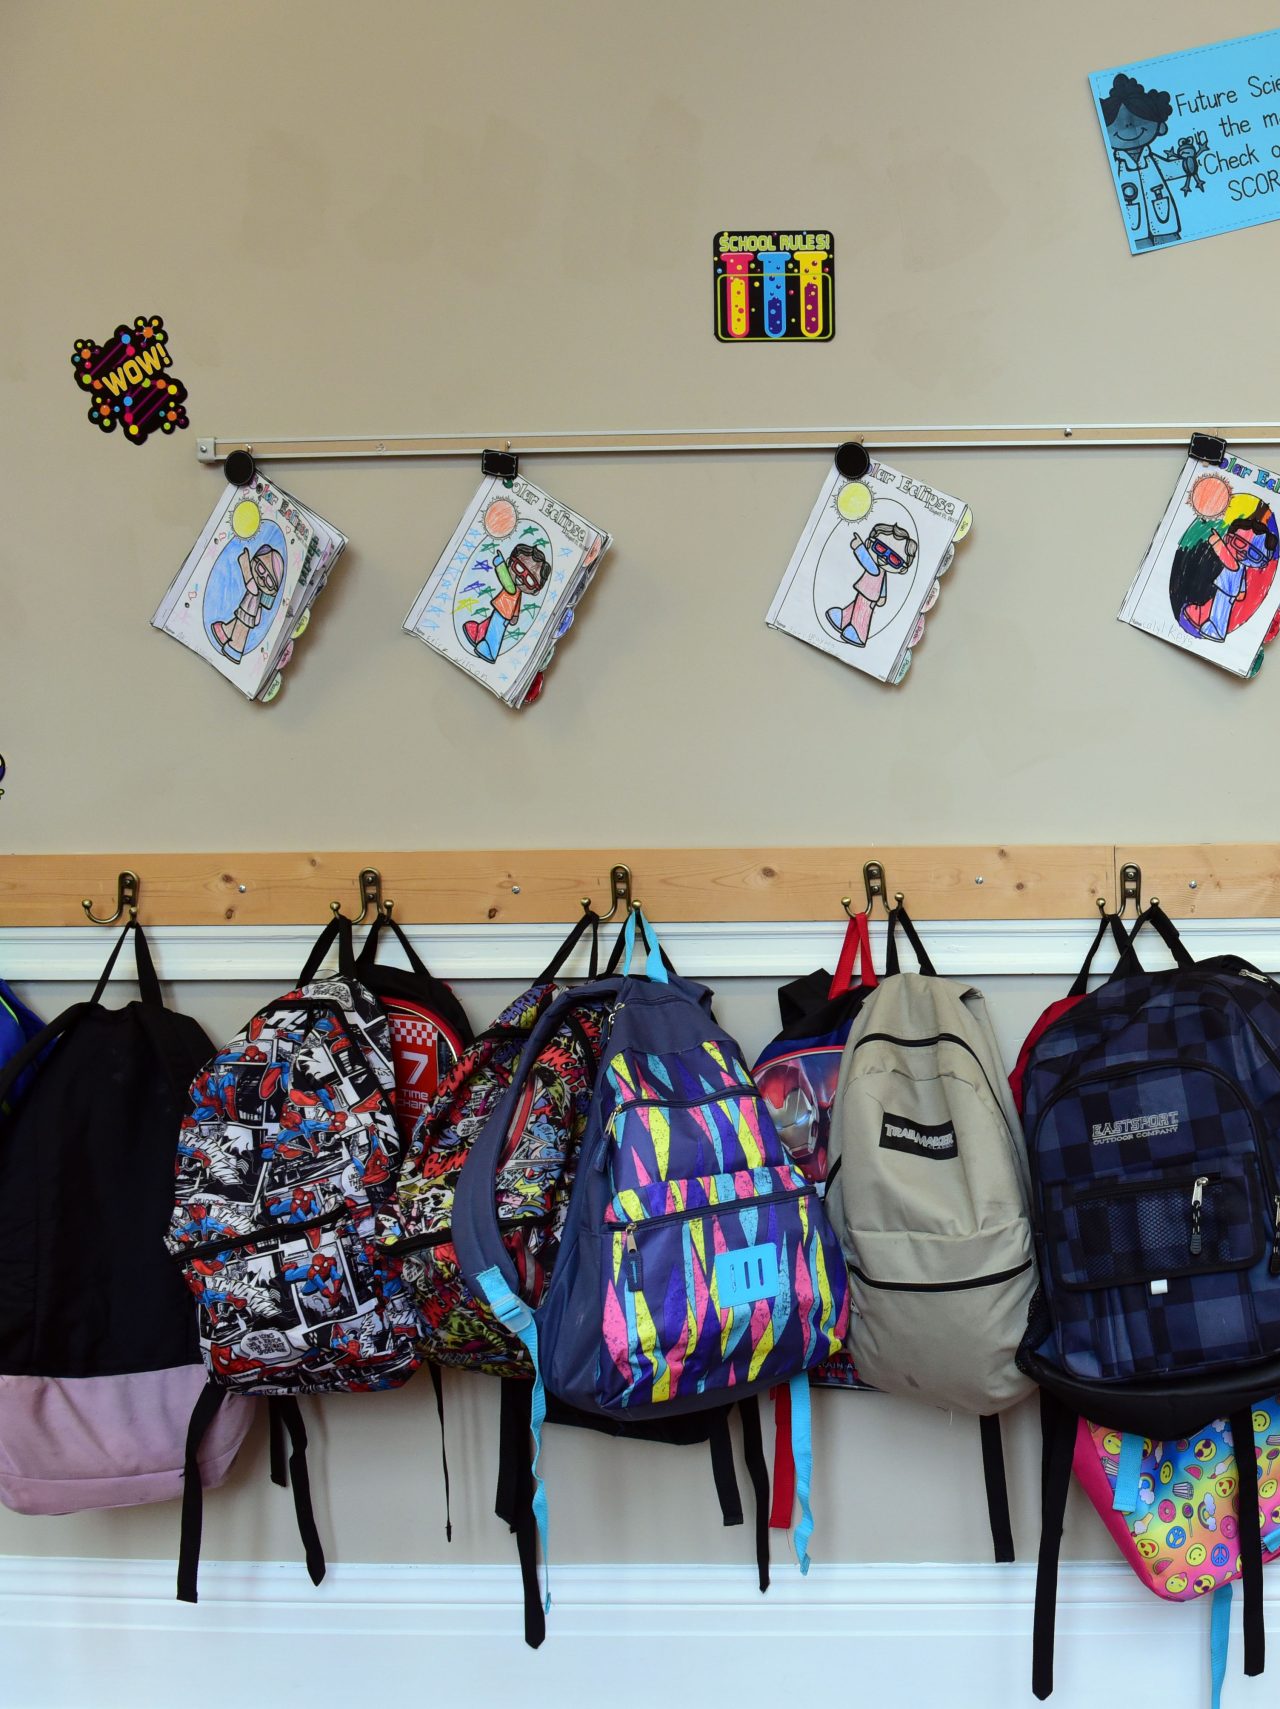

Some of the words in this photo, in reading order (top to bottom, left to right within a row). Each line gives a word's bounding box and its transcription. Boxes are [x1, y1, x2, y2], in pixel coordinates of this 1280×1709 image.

[1175, 90, 1239, 117] Future
[1218, 115, 1251, 138] the
[718, 234, 777, 252] SCHOOL
[779, 233, 831, 251] RULES!
[101, 342, 171, 397] WOW!
[1218, 457, 1252, 480] olar
[896, 475, 956, 516] Eclipse
[538, 496, 588, 543] Eclipse
[401, 1050, 429, 1085] 7
[1092, 1110, 1179, 1138] EASTSPORT
[1093, 1133, 1134, 1146] OUTDOOR
[1136, 1126, 1178, 1139] COMPANY
